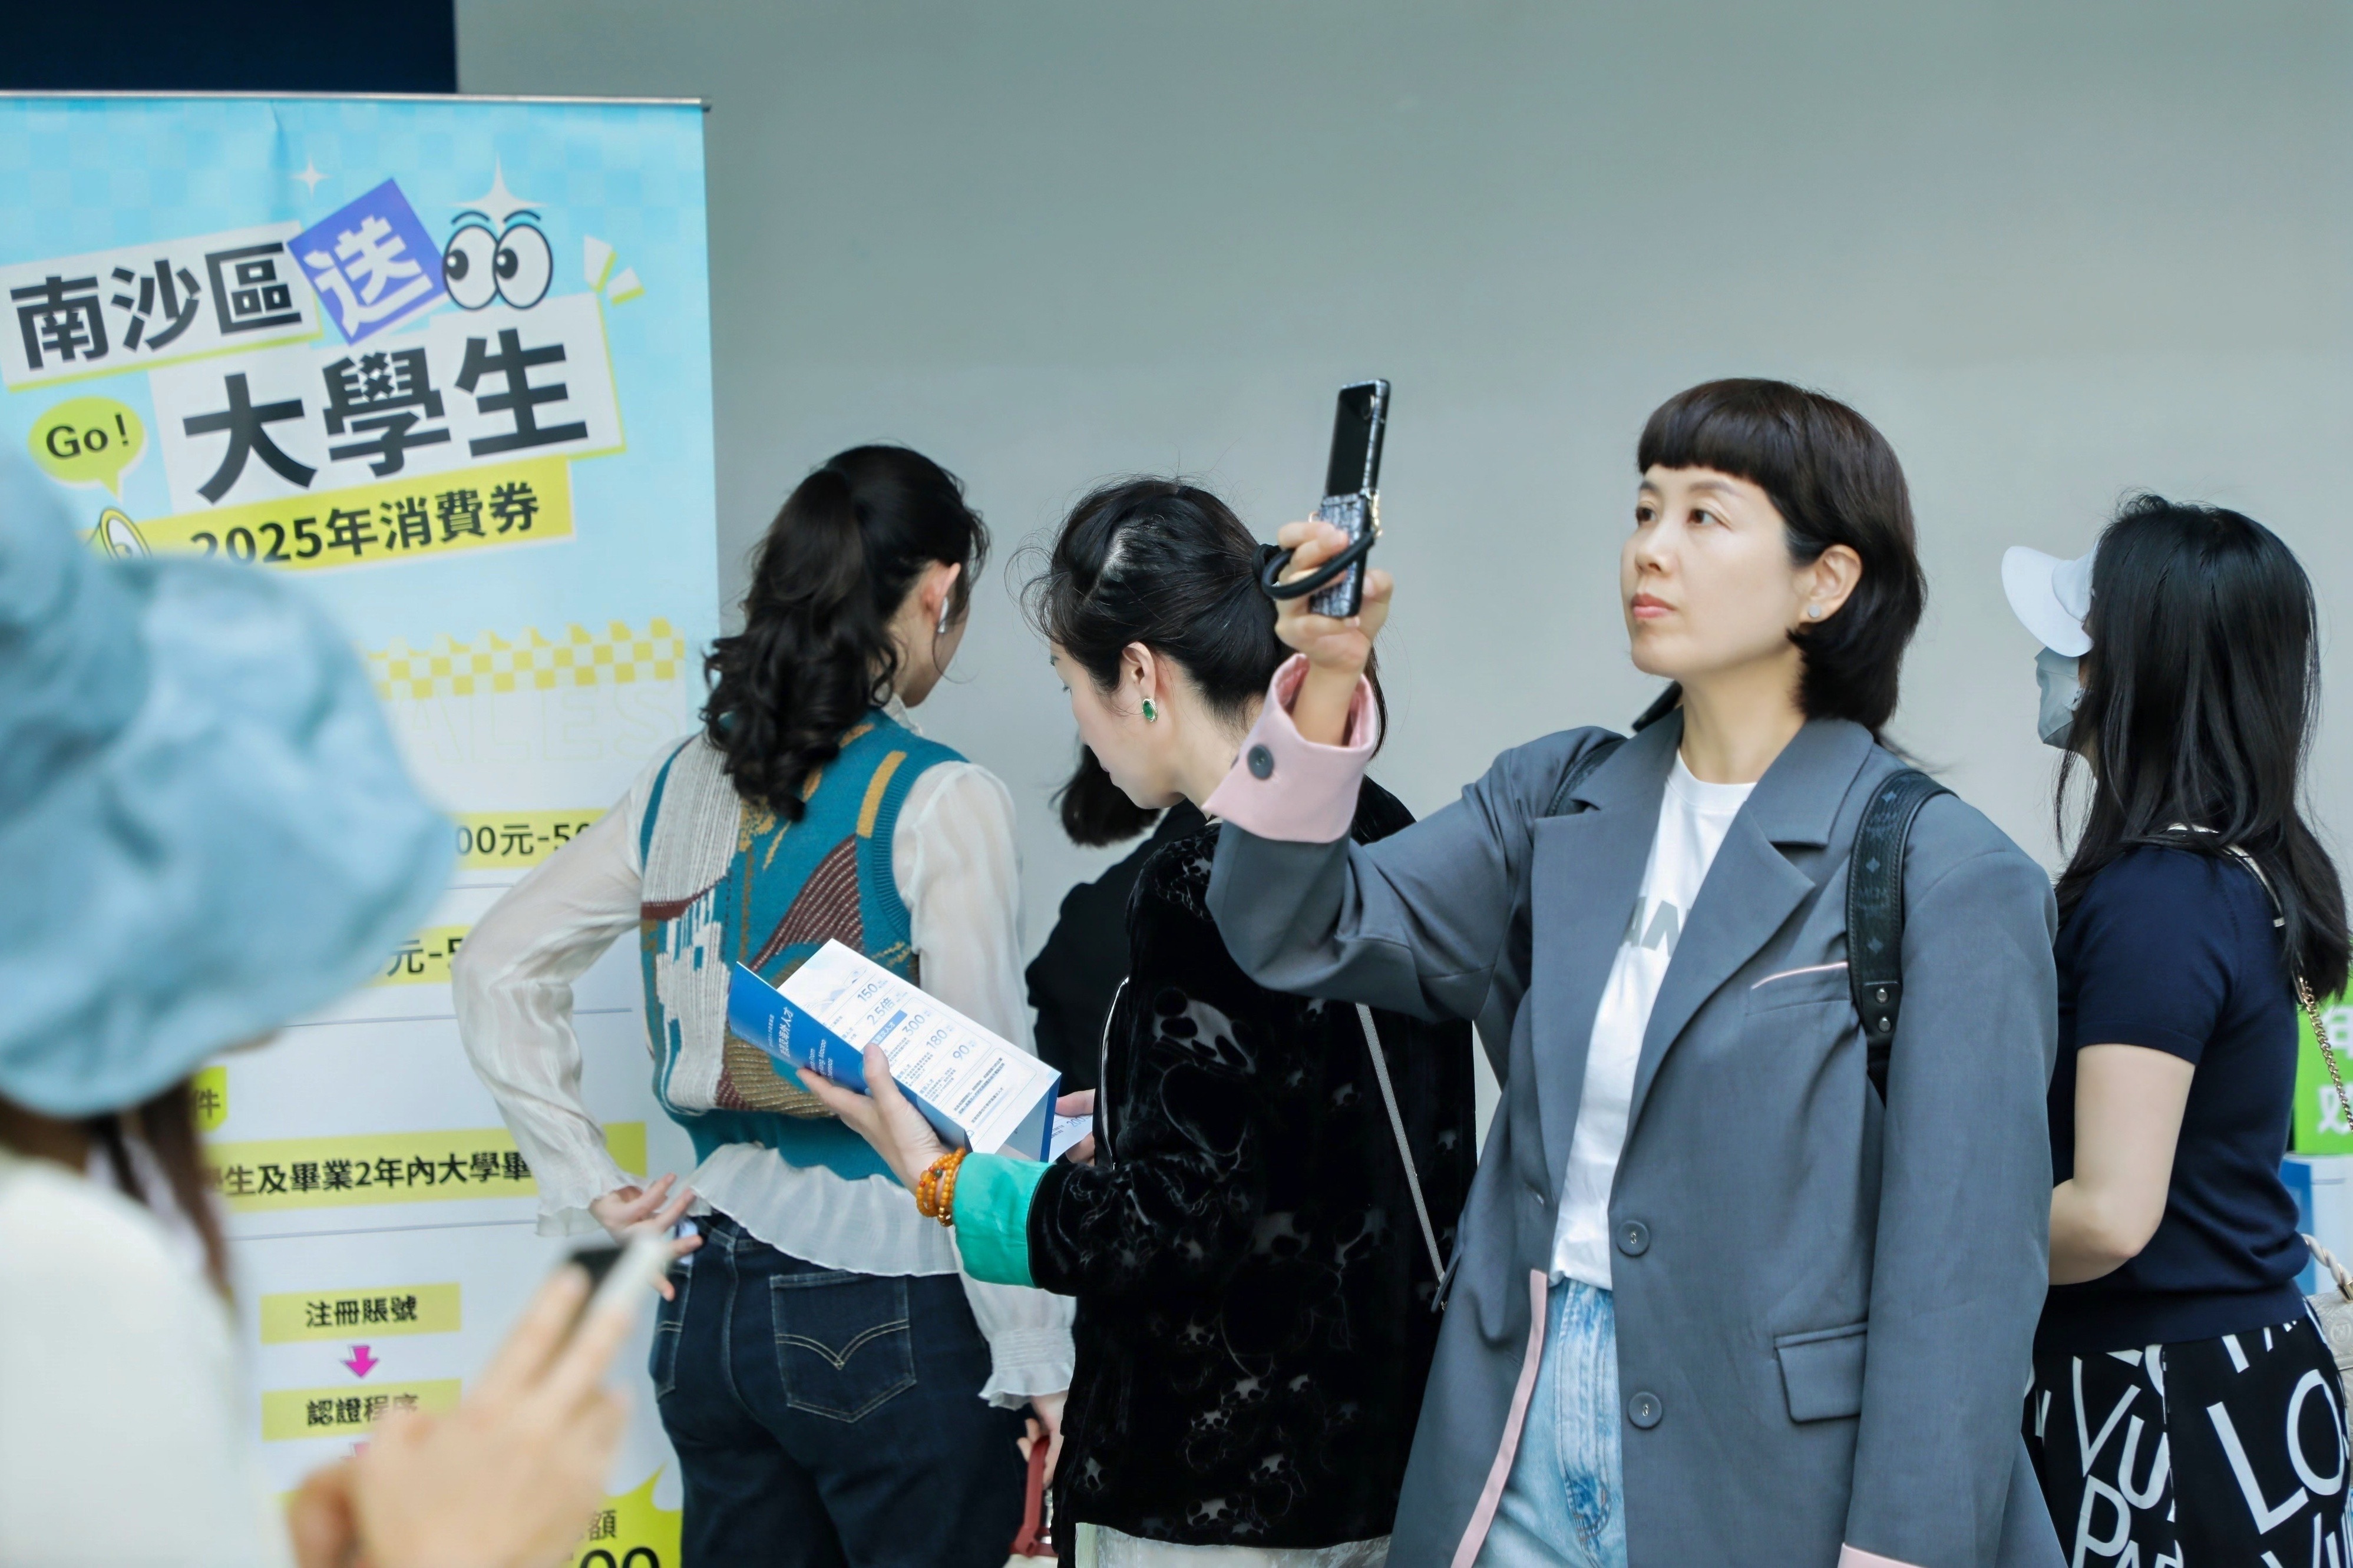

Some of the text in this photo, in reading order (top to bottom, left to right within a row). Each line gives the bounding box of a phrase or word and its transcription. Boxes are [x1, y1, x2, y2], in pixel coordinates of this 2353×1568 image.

[9, 214, 434, 372] 南沙區 送
[181, 327, 589, 505] 大學生
[45, 412, 133, 462] Go!
[190, 481, 540, 567] 2025年消費券
[857, 983, 878, 1002] 150
[902, 1014, 926, 1037] 300
[926, 1028, 948, 1049] 180
[952, 1044, 970, 1060] 90
